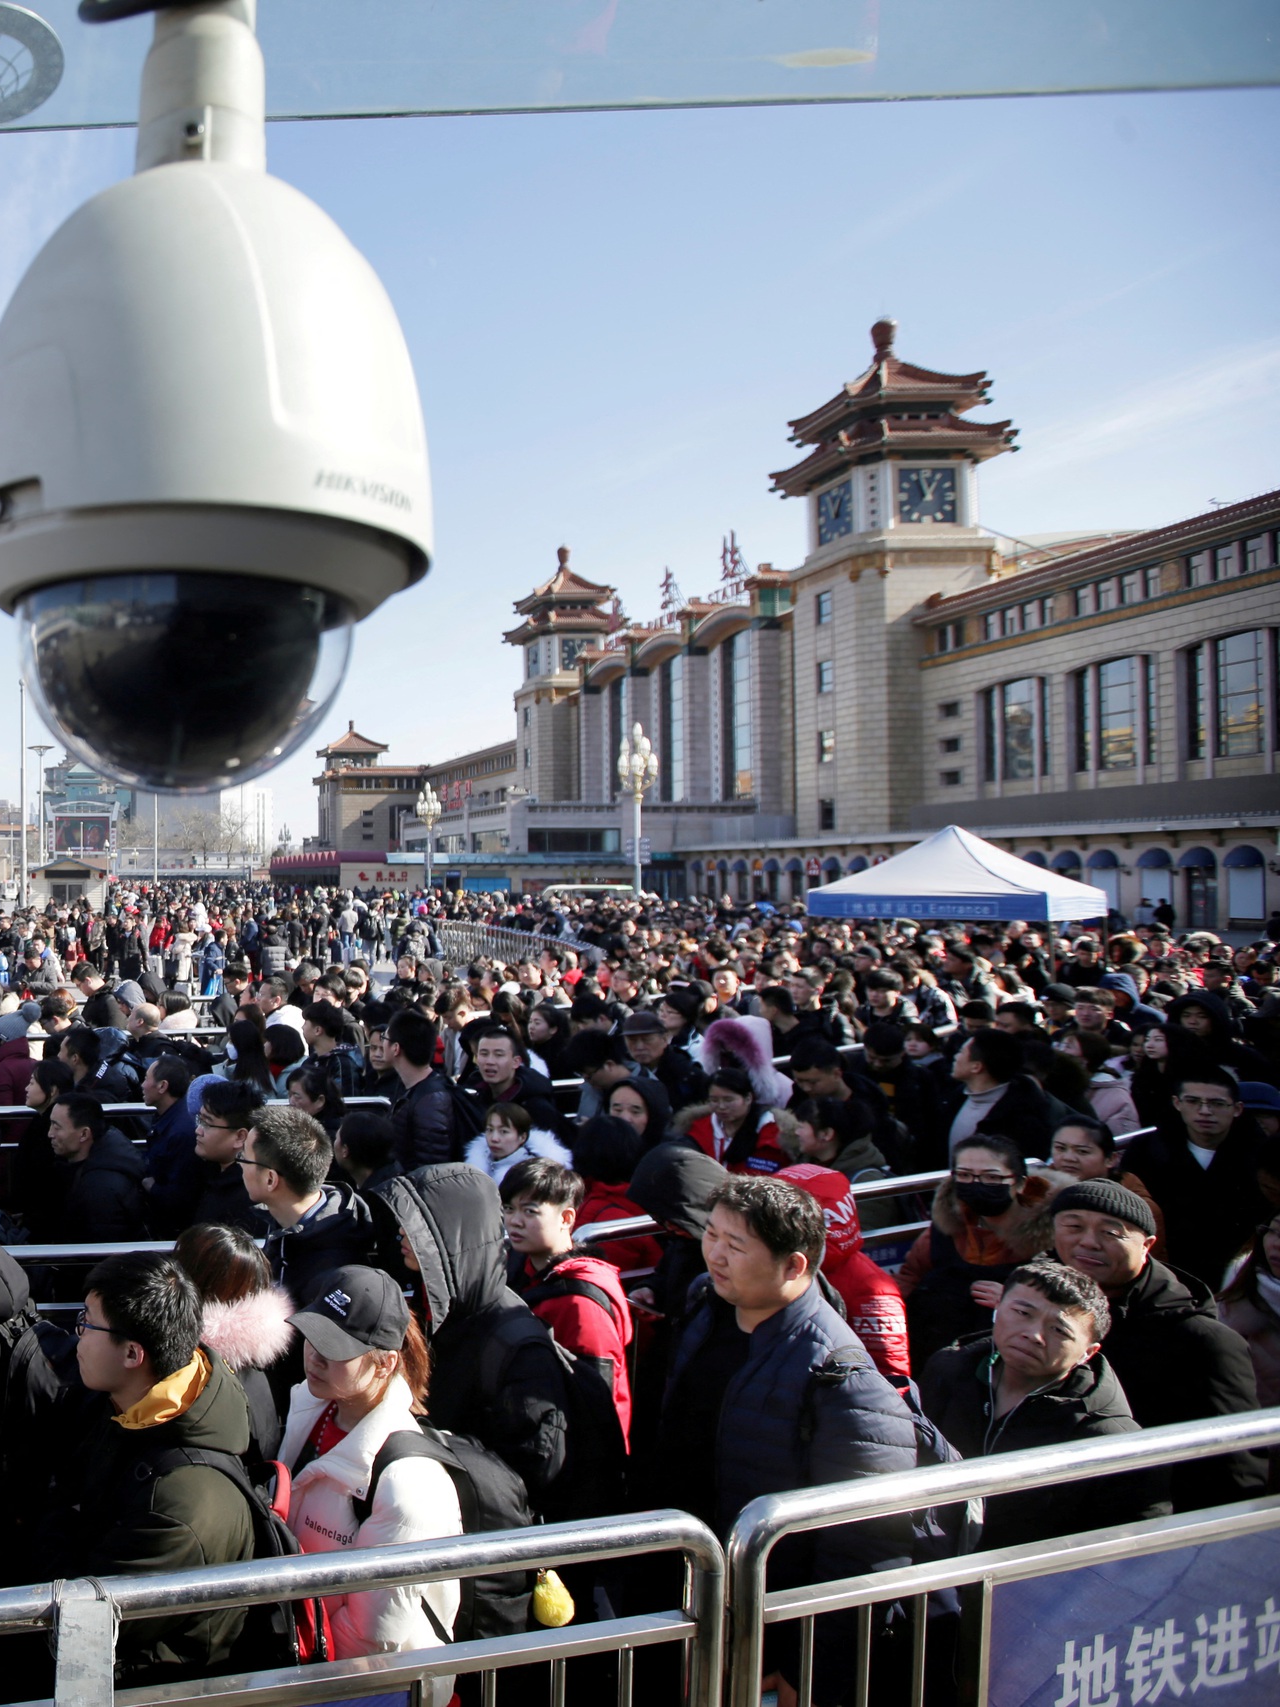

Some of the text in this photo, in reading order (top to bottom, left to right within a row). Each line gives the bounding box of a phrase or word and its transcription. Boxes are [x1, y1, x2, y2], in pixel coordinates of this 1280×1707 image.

[314, 468, 413, 513] HIKVISION
[851, 901, 991, 915] 地铁进站口 Entrance
